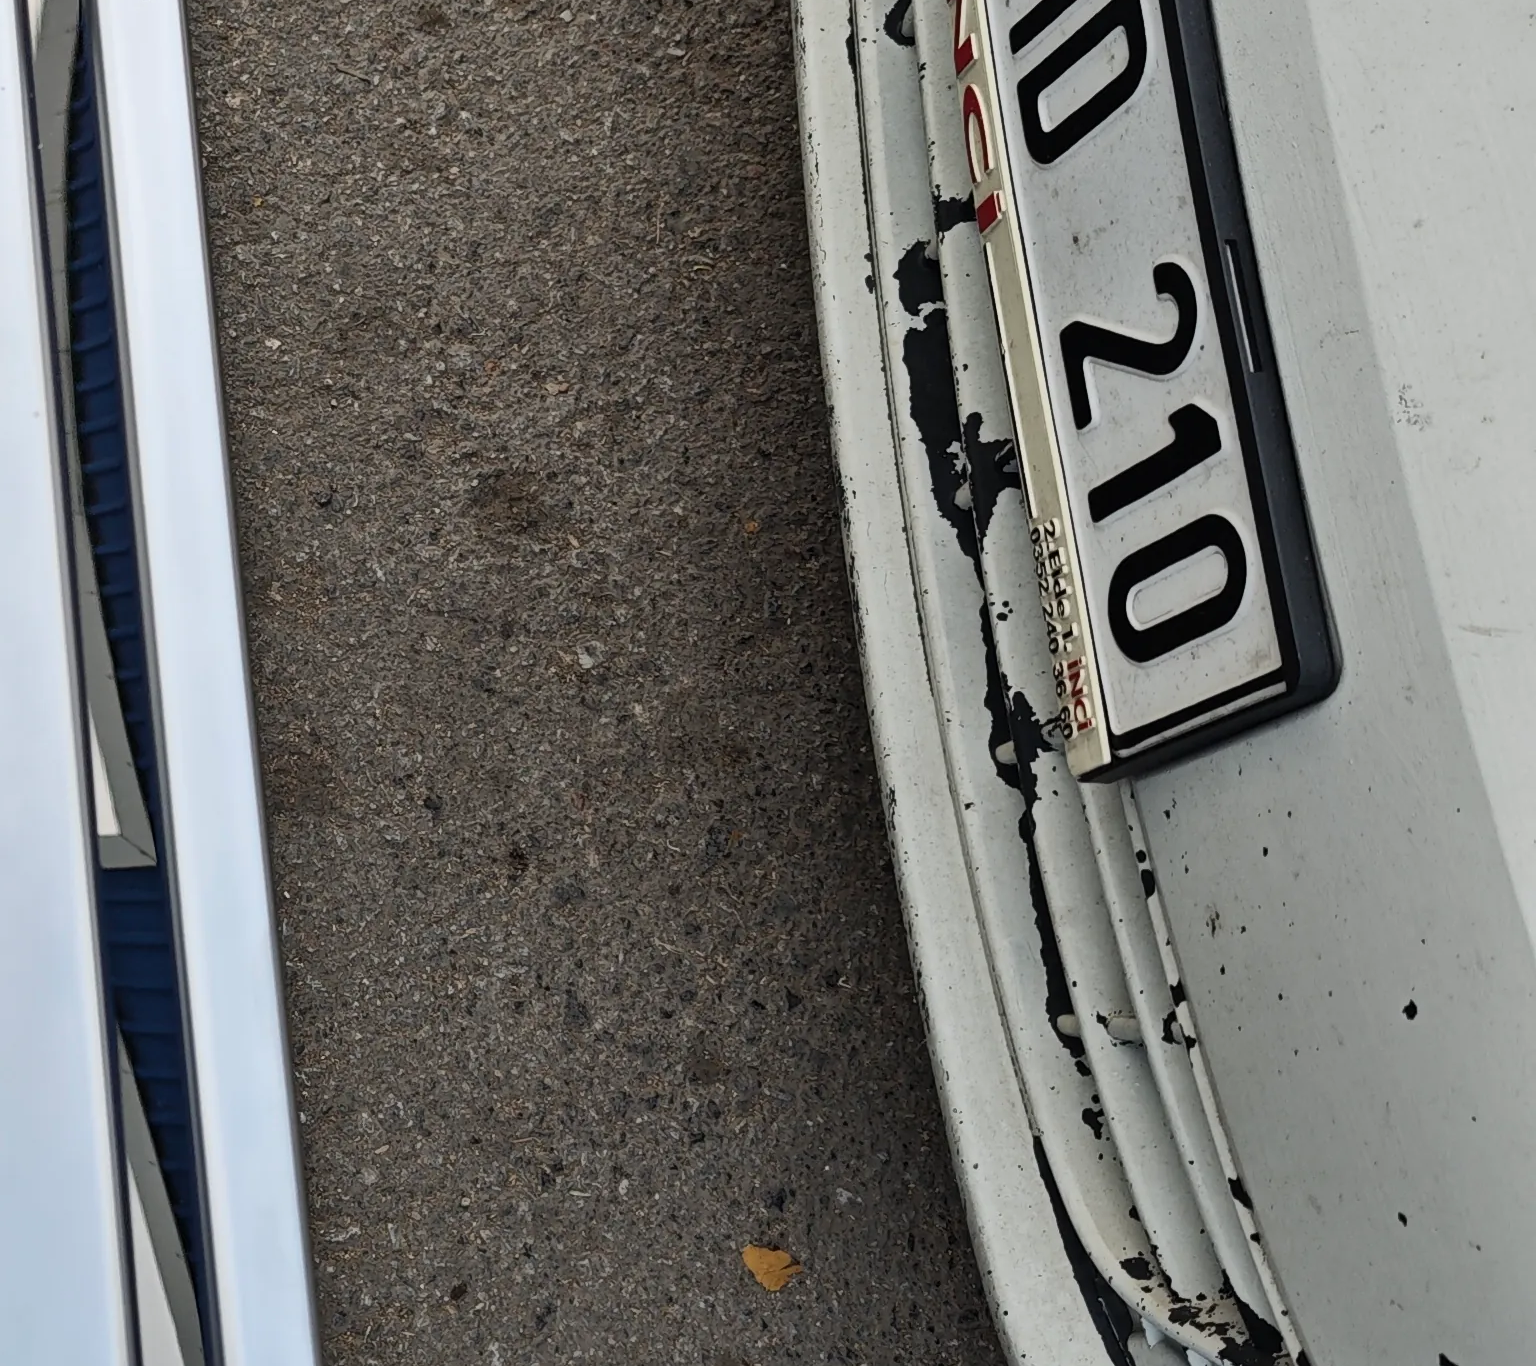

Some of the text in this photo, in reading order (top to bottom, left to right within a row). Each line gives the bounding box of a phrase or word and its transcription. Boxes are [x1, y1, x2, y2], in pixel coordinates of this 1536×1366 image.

[1061, 260, 1247, 666] 210
[1030, 524, 1079, 740] 0352 240 36 60
